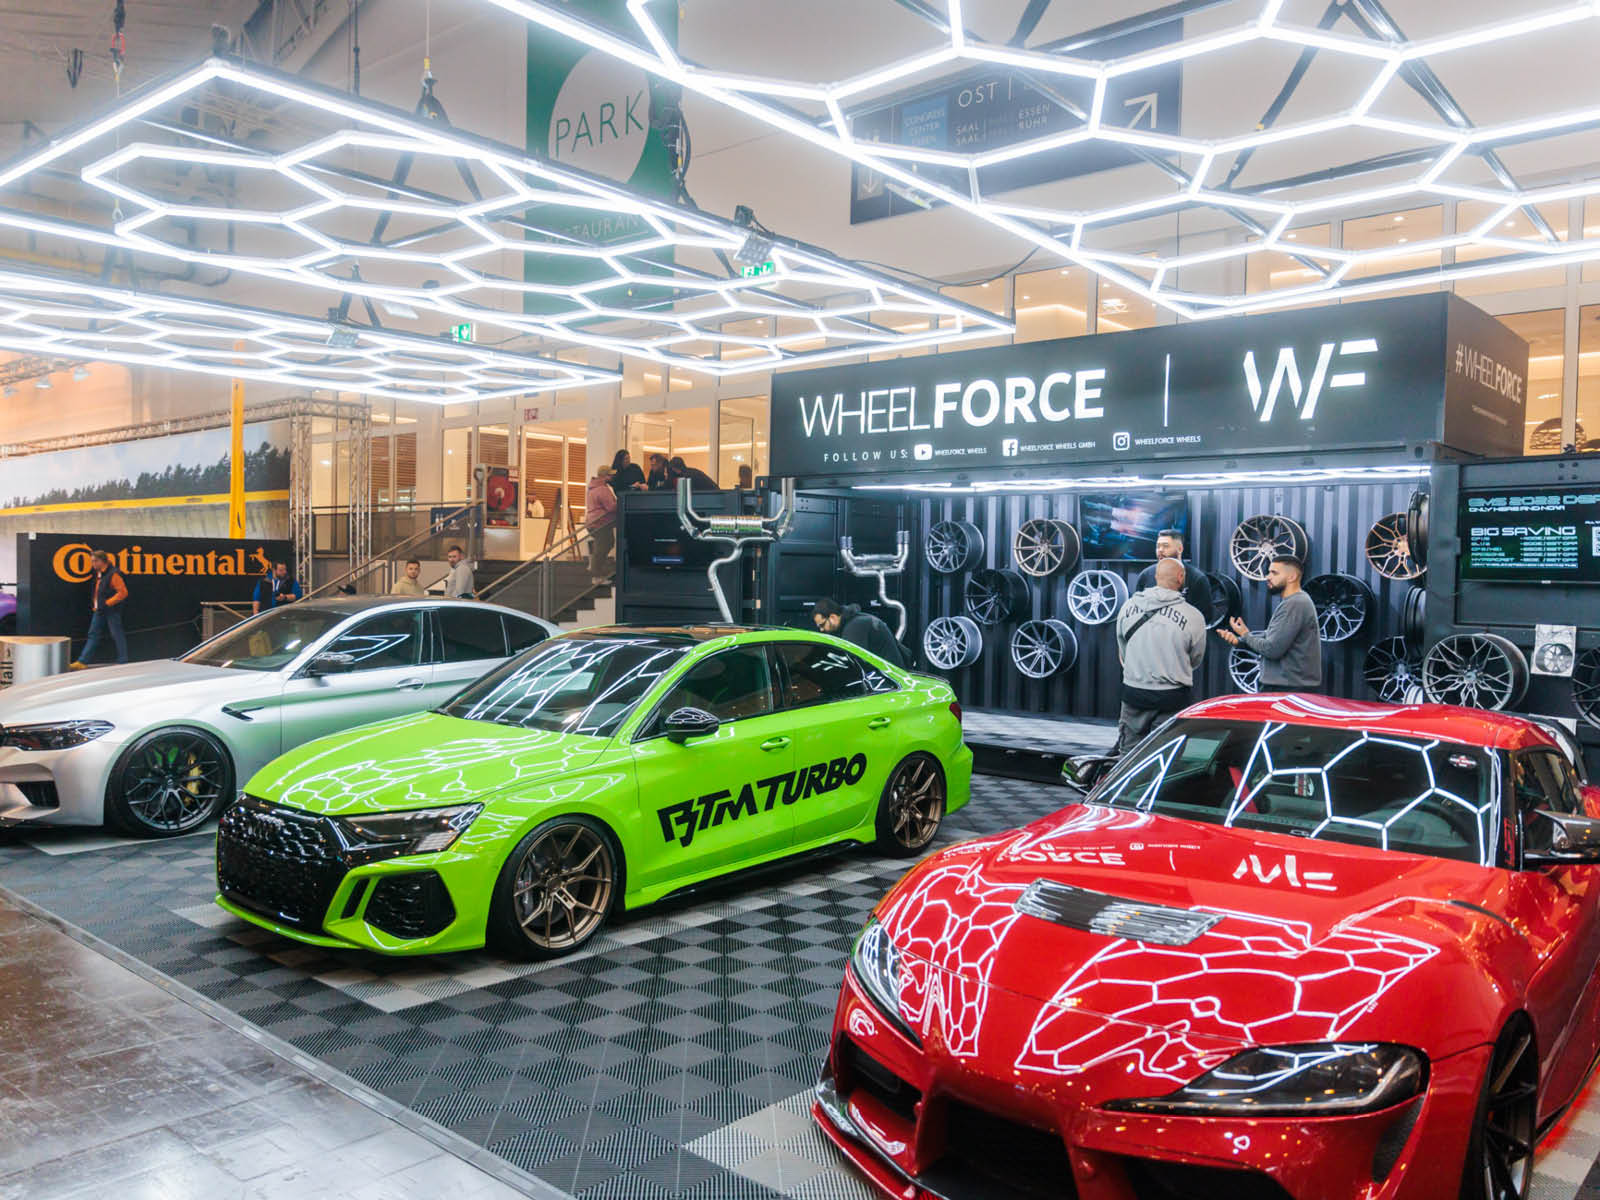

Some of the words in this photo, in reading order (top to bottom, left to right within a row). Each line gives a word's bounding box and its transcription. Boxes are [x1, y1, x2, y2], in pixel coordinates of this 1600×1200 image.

[958, 81, 1000, 108] OST
[555, 90, 644, 159] PARK
[1455, 343, 1523, 405] #WHEELFORCE
[799, 368, 1106, 438] WHEELFORCE
[1055, 442, 1077, 450] WHEELS
[1134, 437, 1174, 446] WHEELFORCE
[1176, 435, 1201, 444] WHEELS
[823, 450, 882, 463] FOLLOW
[967, 447, 988, 455] WHEELS
[1470, 527, 1500, 537] BIG
[1501, 526, 1577, 536] SAVING
[1125, 604, 1188, 631] VAUISH
